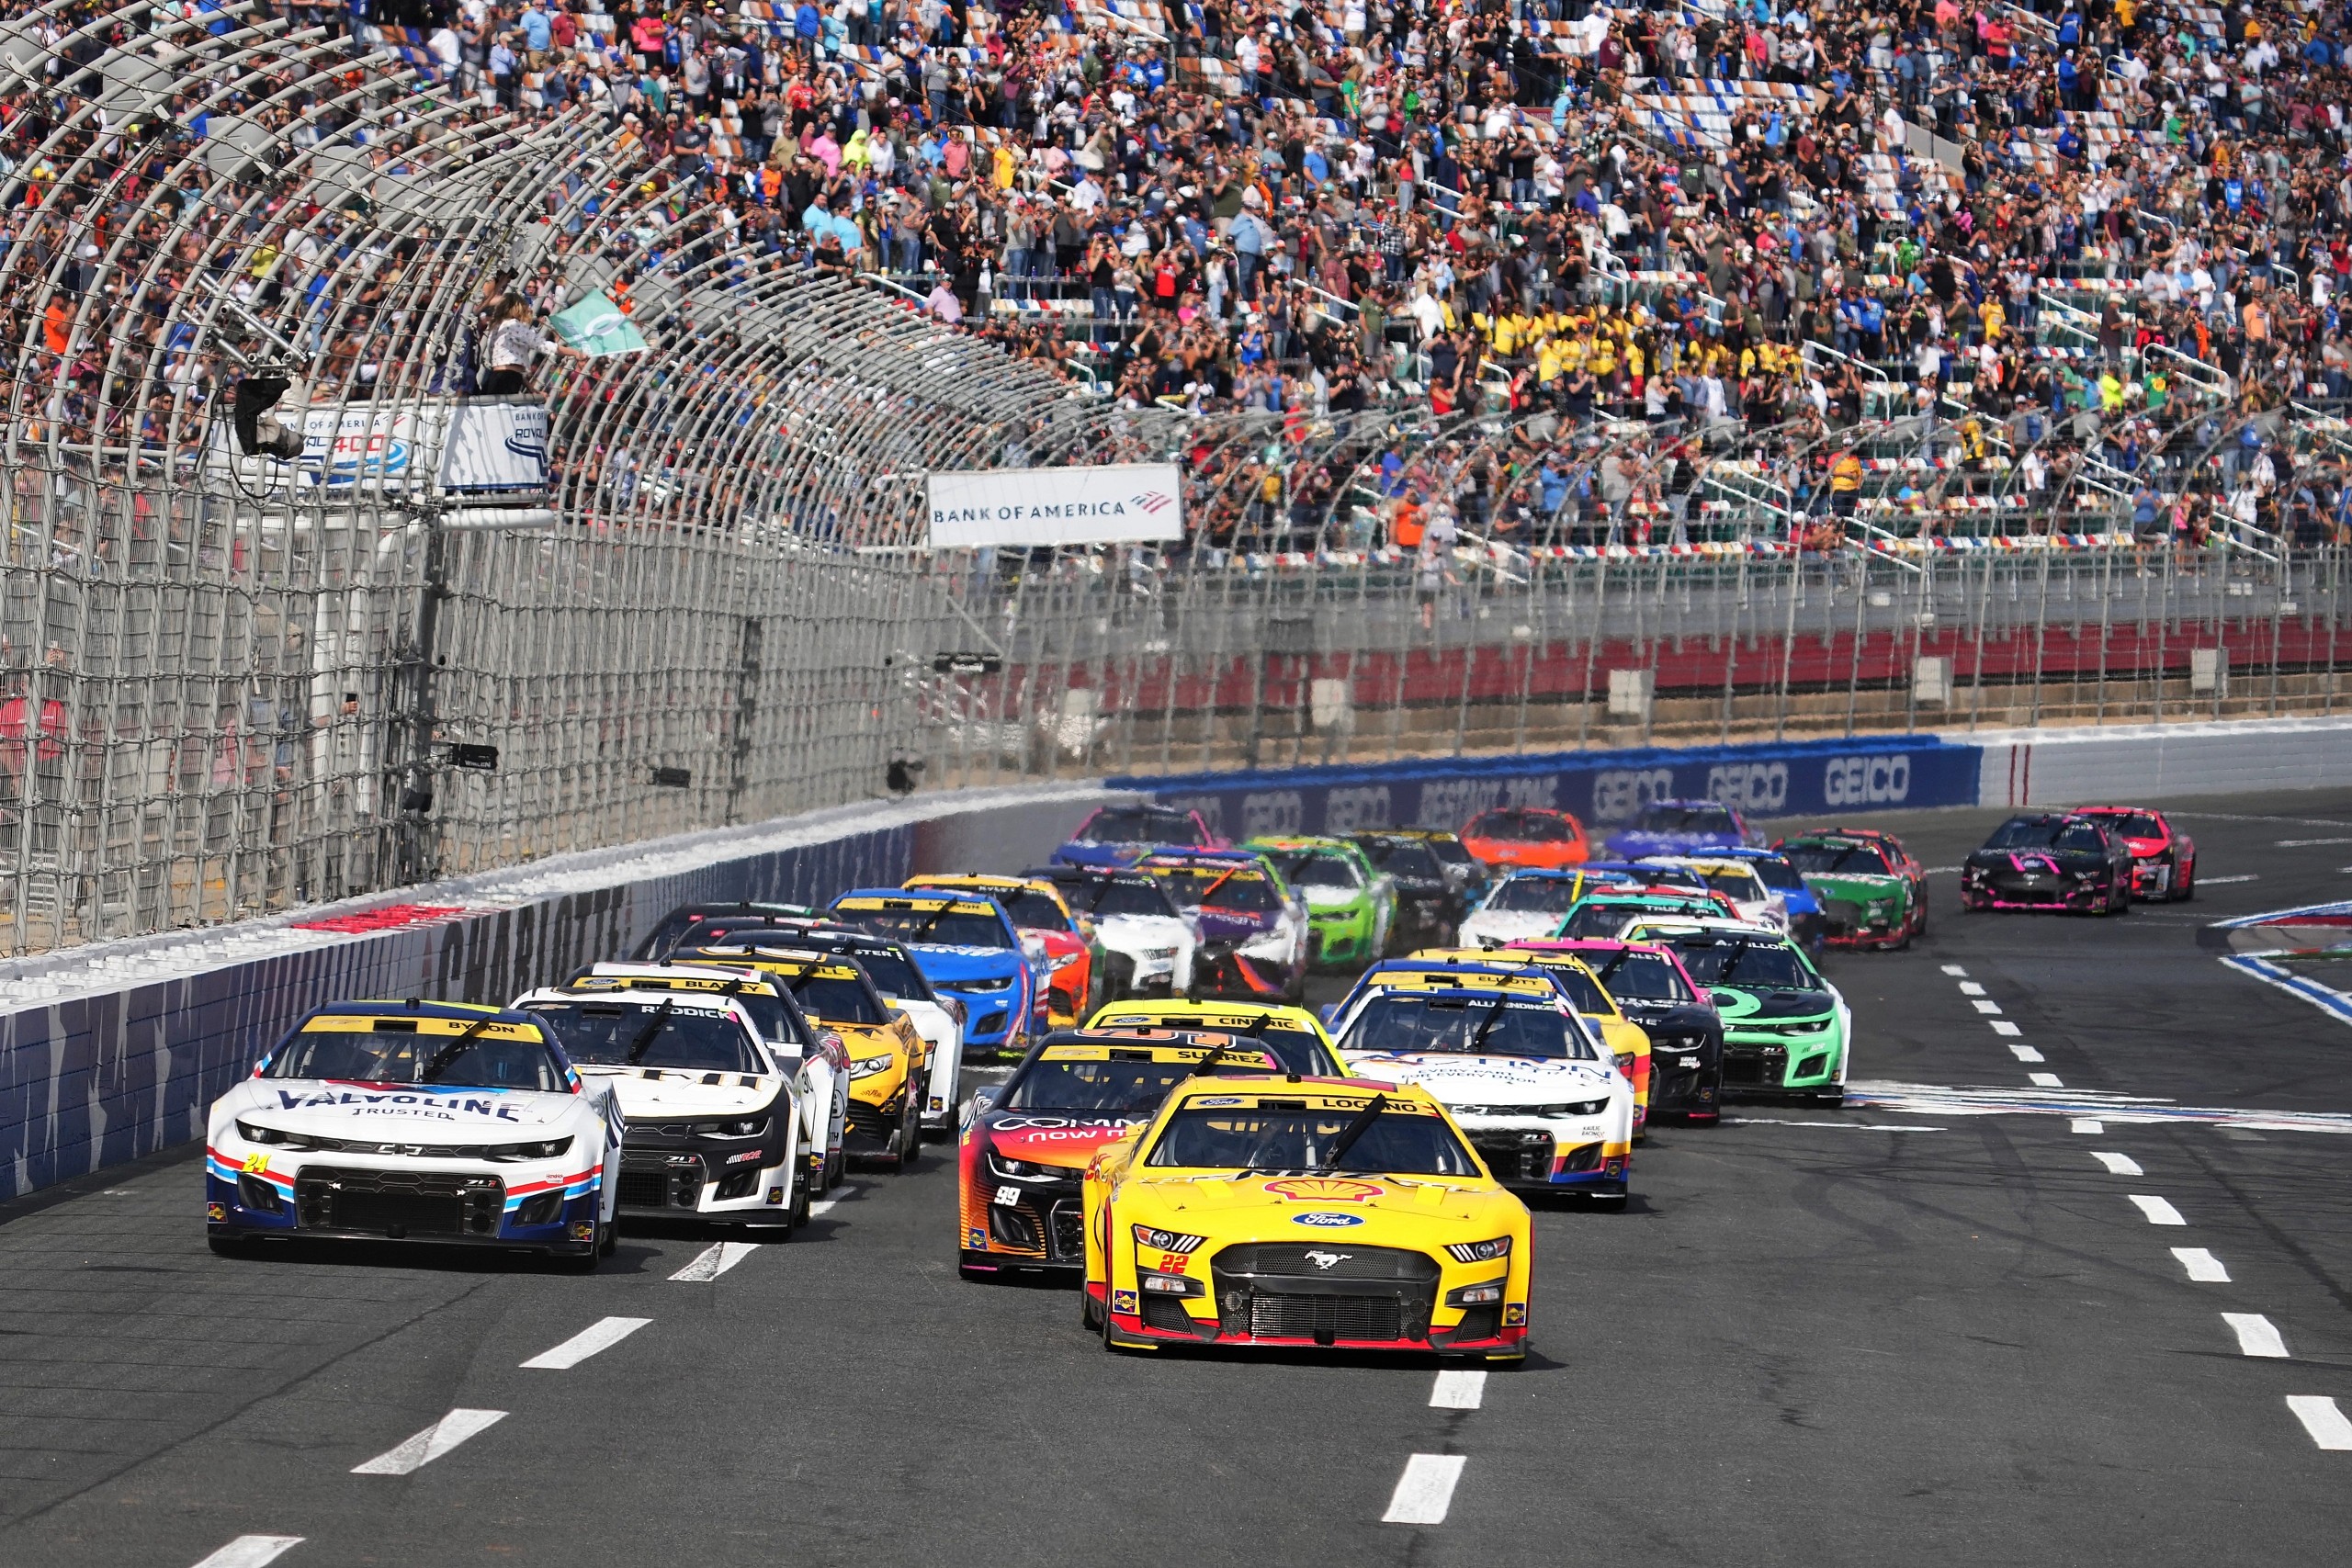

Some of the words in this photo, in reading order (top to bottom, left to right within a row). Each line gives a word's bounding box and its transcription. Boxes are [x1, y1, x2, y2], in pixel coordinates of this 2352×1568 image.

[327, 419, 380, 430] AMERIA
[933, 507, 991, 523] BANK
[998, 505, 1024, 521] OF
[1030, 502, 1126, 519] AMERICA
[1708, 762, 1790, 812] GEICO
[1825, 754, 1911, 807] GEICO
[928, 901, 980, 909] LASON
[831, 946, 892, 957] CSTER
[1736, 941, 1789, 952] ILLON
[1628, 953, 1662, 961] ALEY
[684, 980, 760, 992] BLAEY
[1478, 975, 1538, 986] ELLOTT
[641, 1005, 731, 1020] RDDICK
[448, 1021, 515, 1033] BYON
[1218, 1018, 1295, 1029] CINRIC
[1178, 1050, 1267, 1064] SUREZ
[277, 1089, 526, 1123] VALVOLINE
[1322, 1099, 1419, 1112] LOGNO
[1028, 1130, 1098, 1143] now
[241, 1152, 271, 1174] 24
[993, 1185, 1022, 1207] 99
[1158, 1254, 1190, 1275] 22
